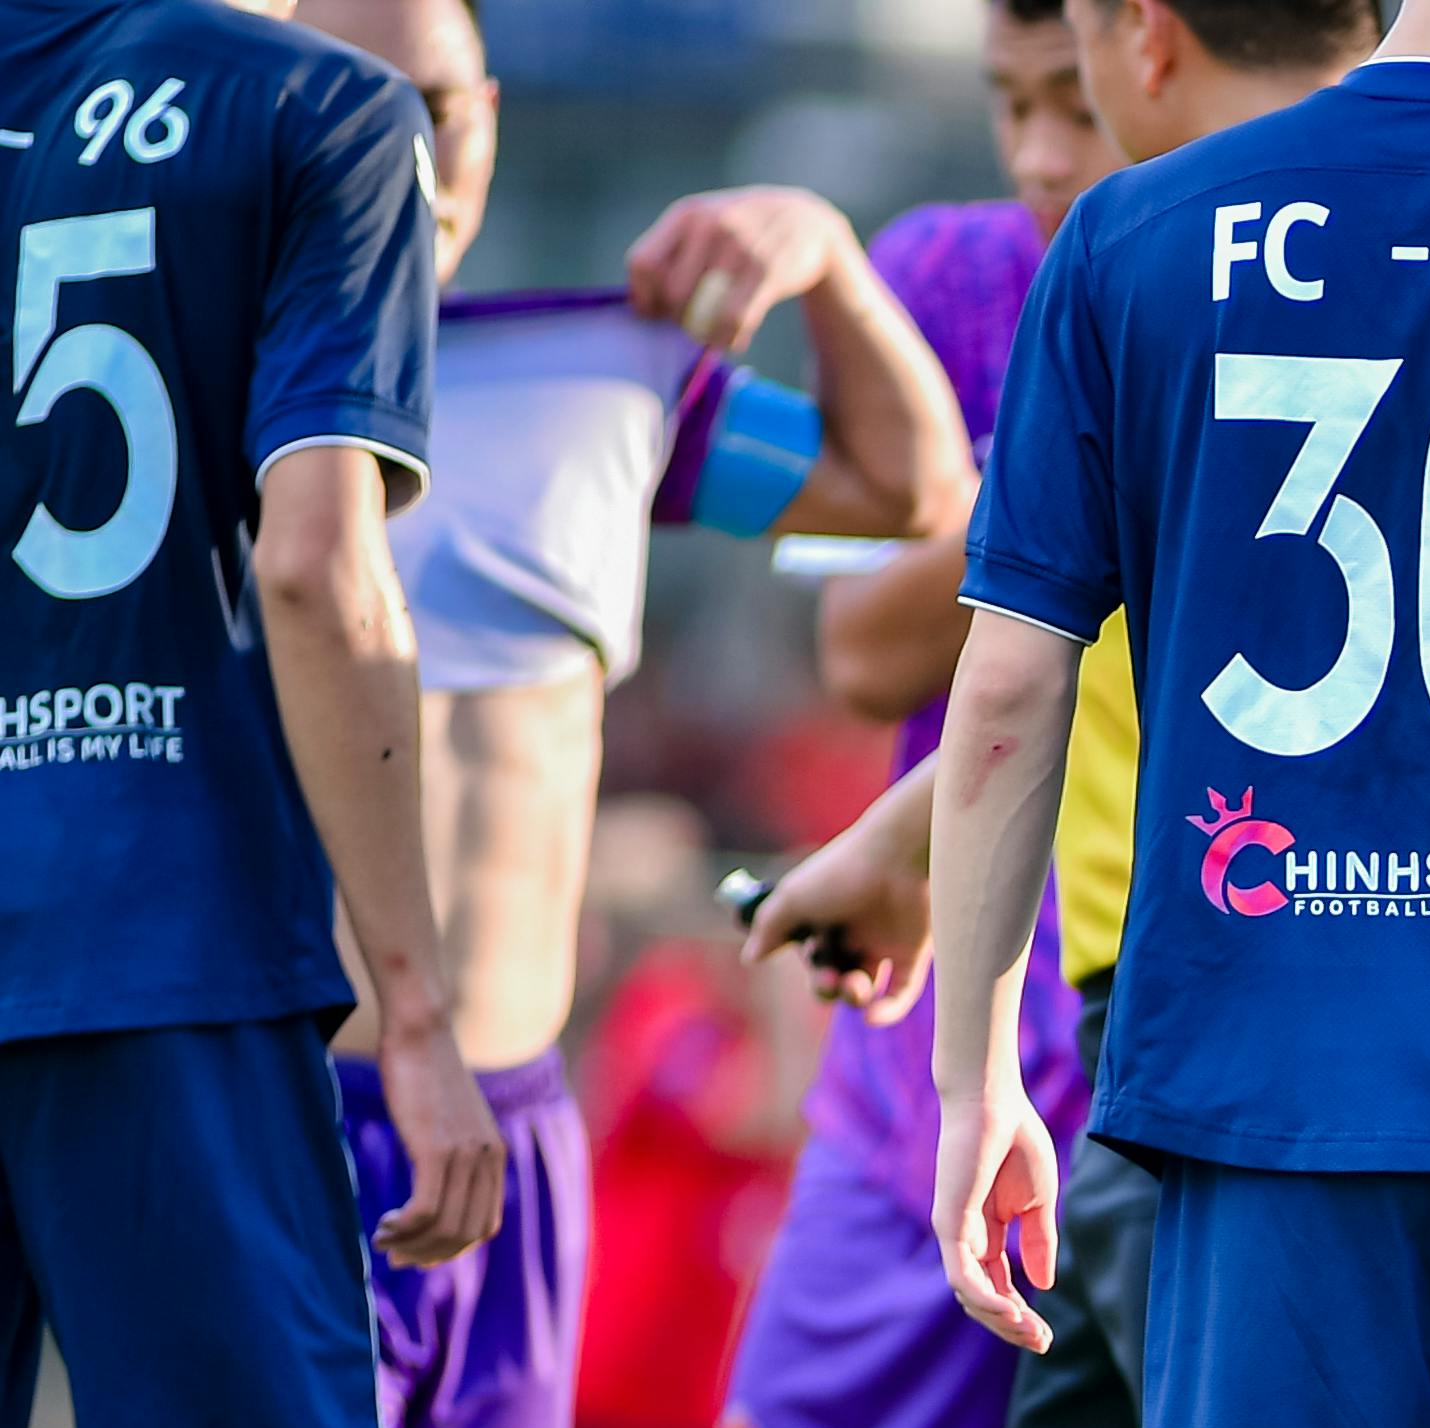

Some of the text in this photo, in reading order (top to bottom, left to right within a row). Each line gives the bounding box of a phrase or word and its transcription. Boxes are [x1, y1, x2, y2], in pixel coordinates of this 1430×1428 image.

[74, 77, 190, 165] 96
[1212, 202, 1330, 301] FC
[1391, 245, 1429, 261] -
[12, 206, 178, 600] 5
[47, 736, 75, 763] IS
[81, 733, 123, 762] MY
[129, 733, 184, 763] LIFE
